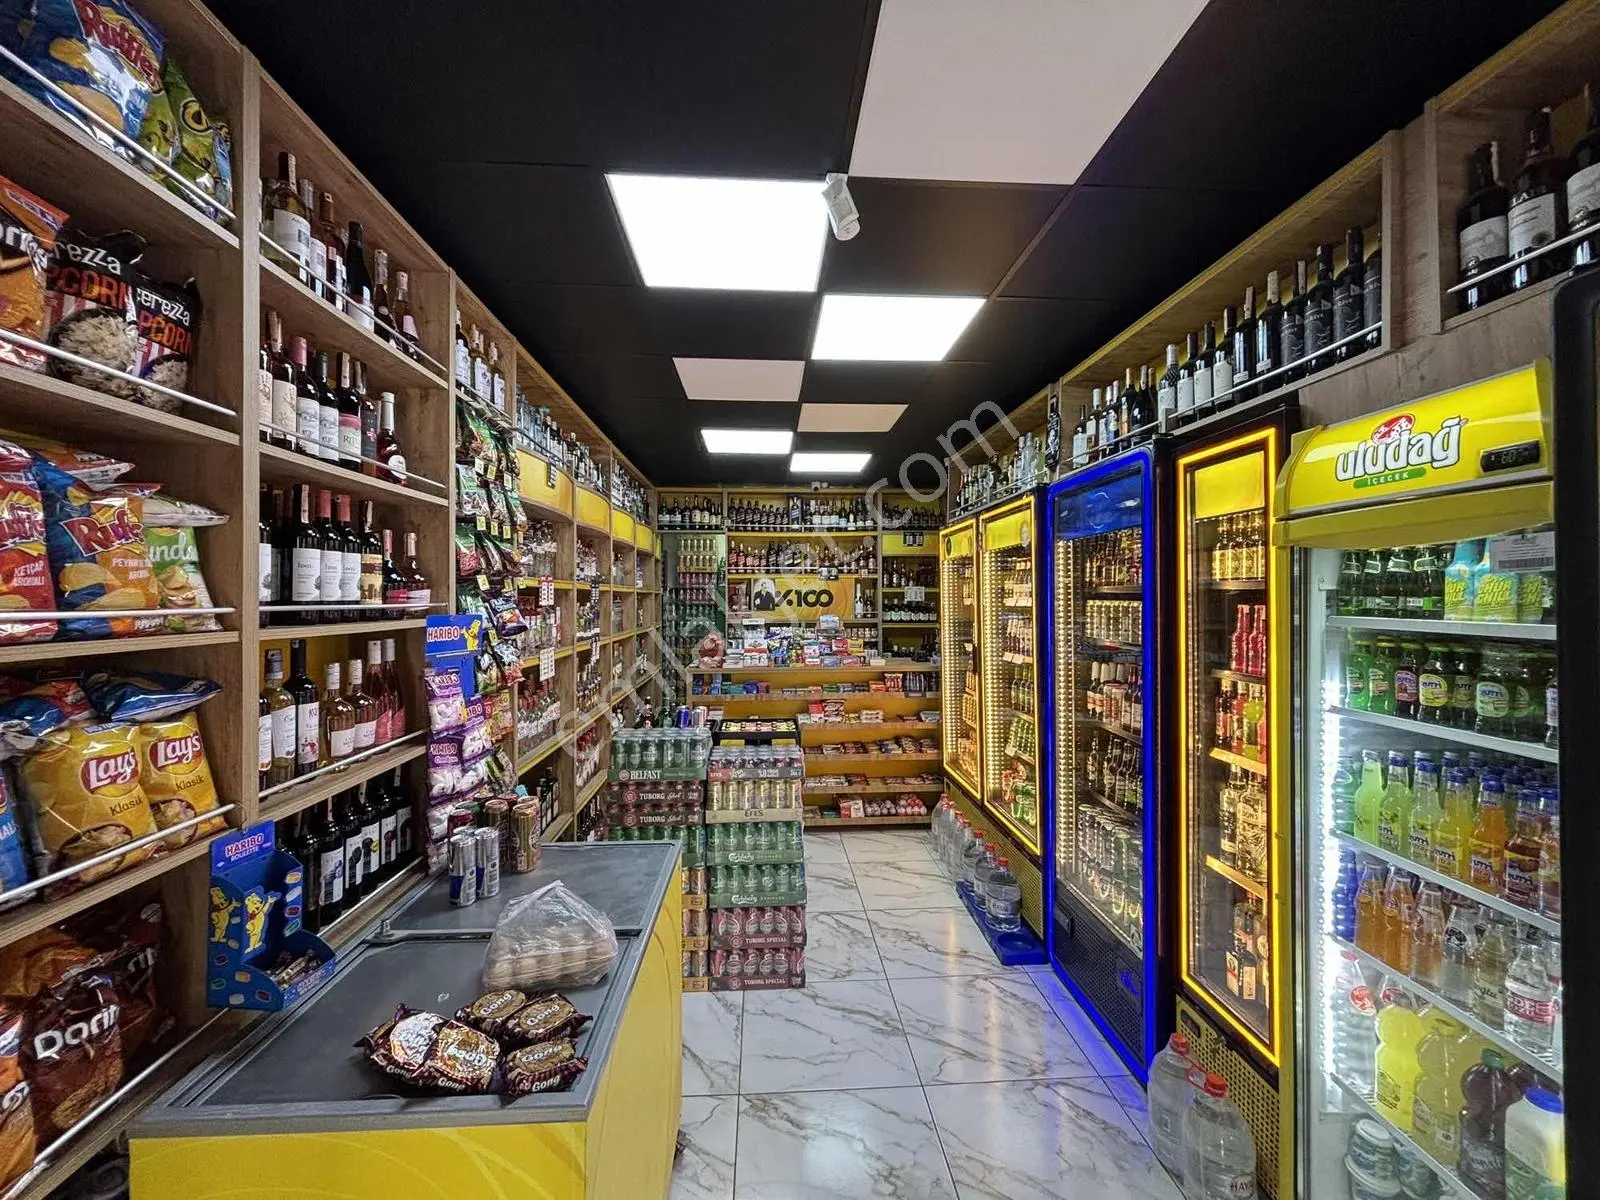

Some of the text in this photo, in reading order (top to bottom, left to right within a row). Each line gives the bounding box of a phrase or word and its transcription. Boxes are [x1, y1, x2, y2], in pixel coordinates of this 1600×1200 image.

[1335, 416, 1463, 481] uludağ
[427, 625, 460, 643] HARIBO
[156, 733, 203, 768] Lay's
[87, 748, 137, 790] Lay's
[630, 770, 662, 780] BELFAST
[174, 775, 206, 792] Klasik
[639, 792, 665, 800] TUBORG
[639, 815, 666, 824] TUBORG
[744, 810, 764, 818] EFES
[225, 833, 265, 858] HARIBO
[728, 852, 755, 863] Carlsberg
[731, 894, 758, 905] Carlsberg
[479, 992, 513, 1017] Gong
[526, 1003, 561, 1026] Gong
[521, 1043, 563, 1063] Gong
[386, 1064, 414, 1080] Gong
[437, 1076, 467, 1092] Gong
[532, 1074, 561, 1093] Gong
